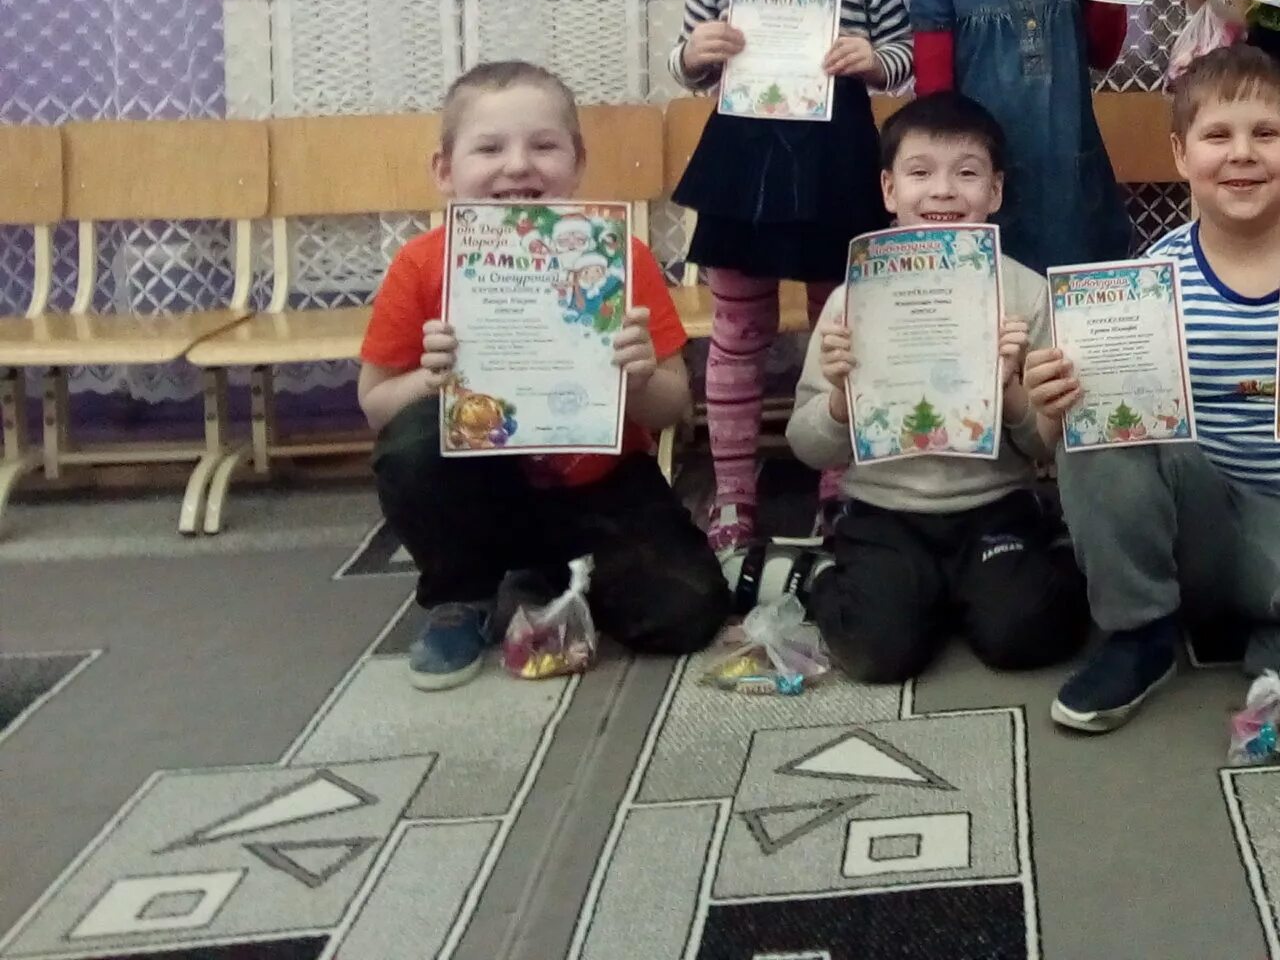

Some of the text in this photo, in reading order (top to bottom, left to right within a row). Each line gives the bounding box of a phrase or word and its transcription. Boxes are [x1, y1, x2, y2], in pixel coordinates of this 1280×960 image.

[457, 252, 560, 271] ГРАМОТА
[863, 256, 950, 277] ГРАМОТА
[1067, 288, 1136, 307] ГРАМОТА
